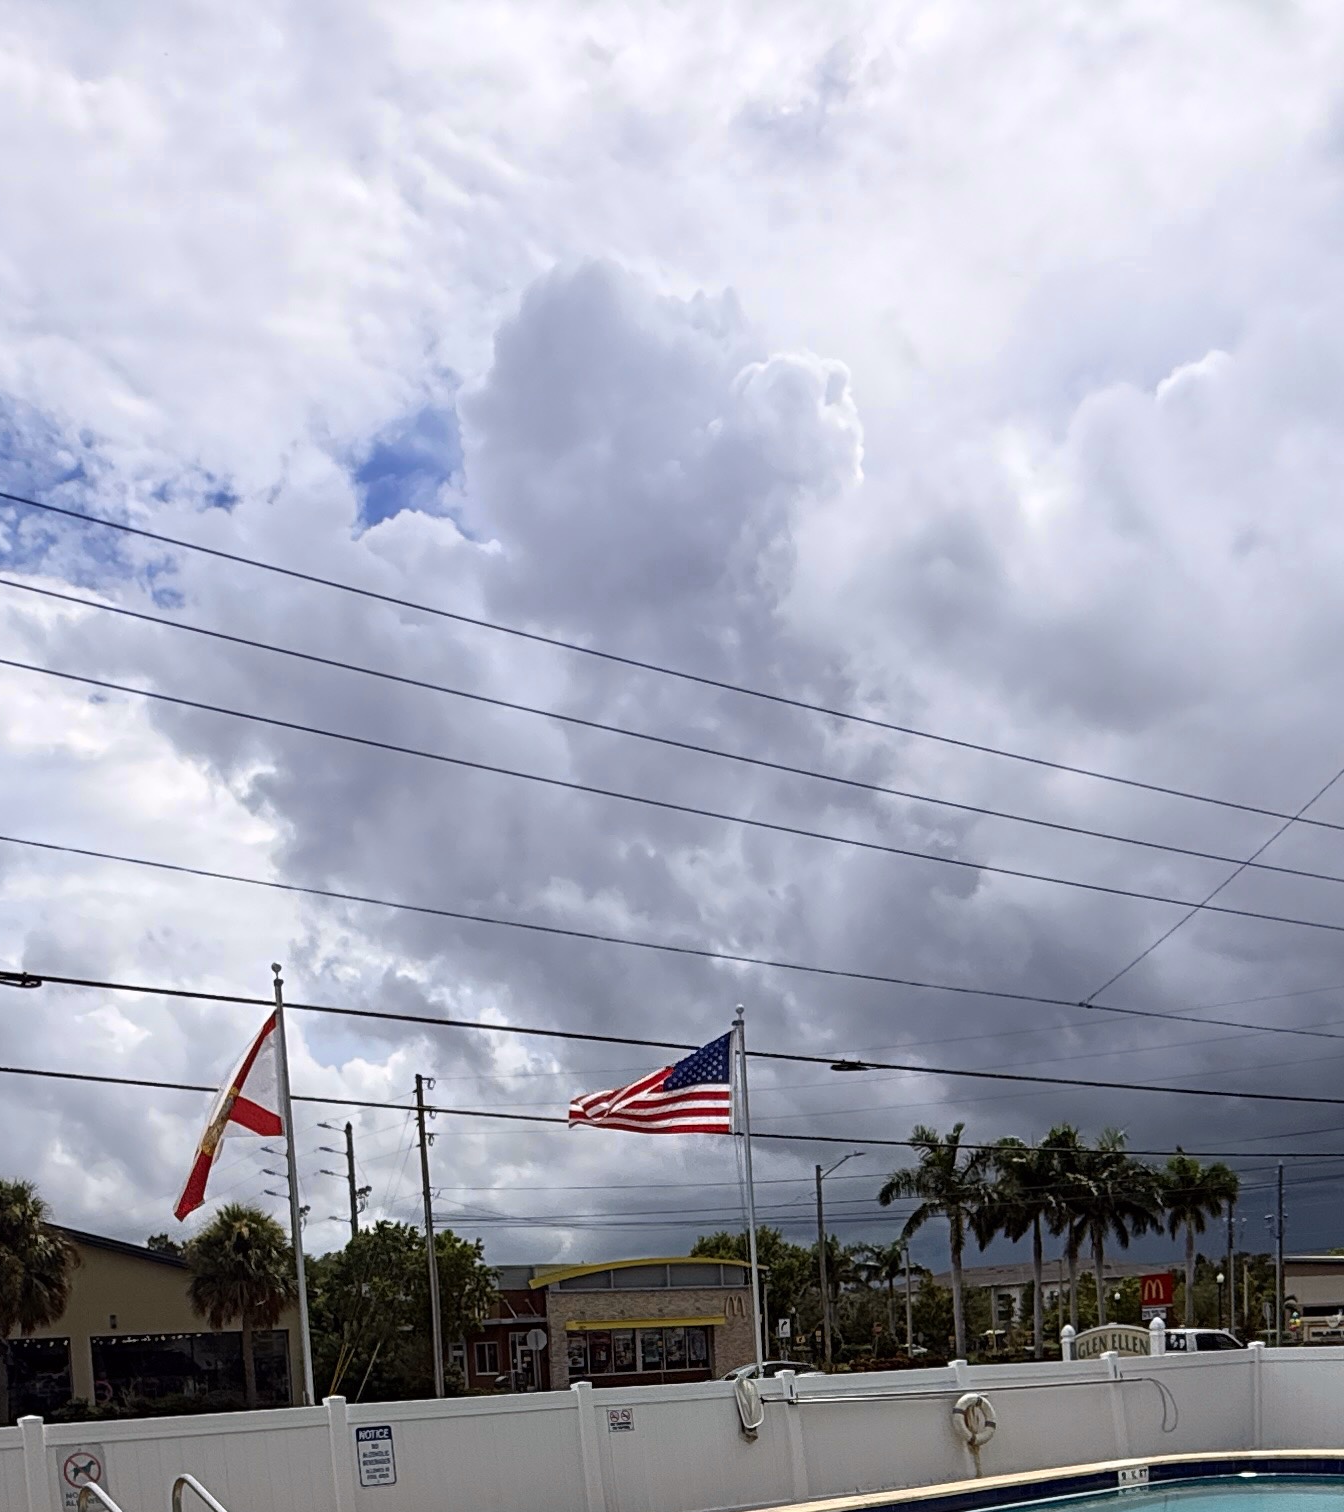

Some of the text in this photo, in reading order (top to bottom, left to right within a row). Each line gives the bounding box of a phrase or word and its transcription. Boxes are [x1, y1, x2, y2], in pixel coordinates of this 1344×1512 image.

[1078, 1333, 1150, 1359] GLEN ELLEN
[359, 1428, 389, 1440] NOTICE
